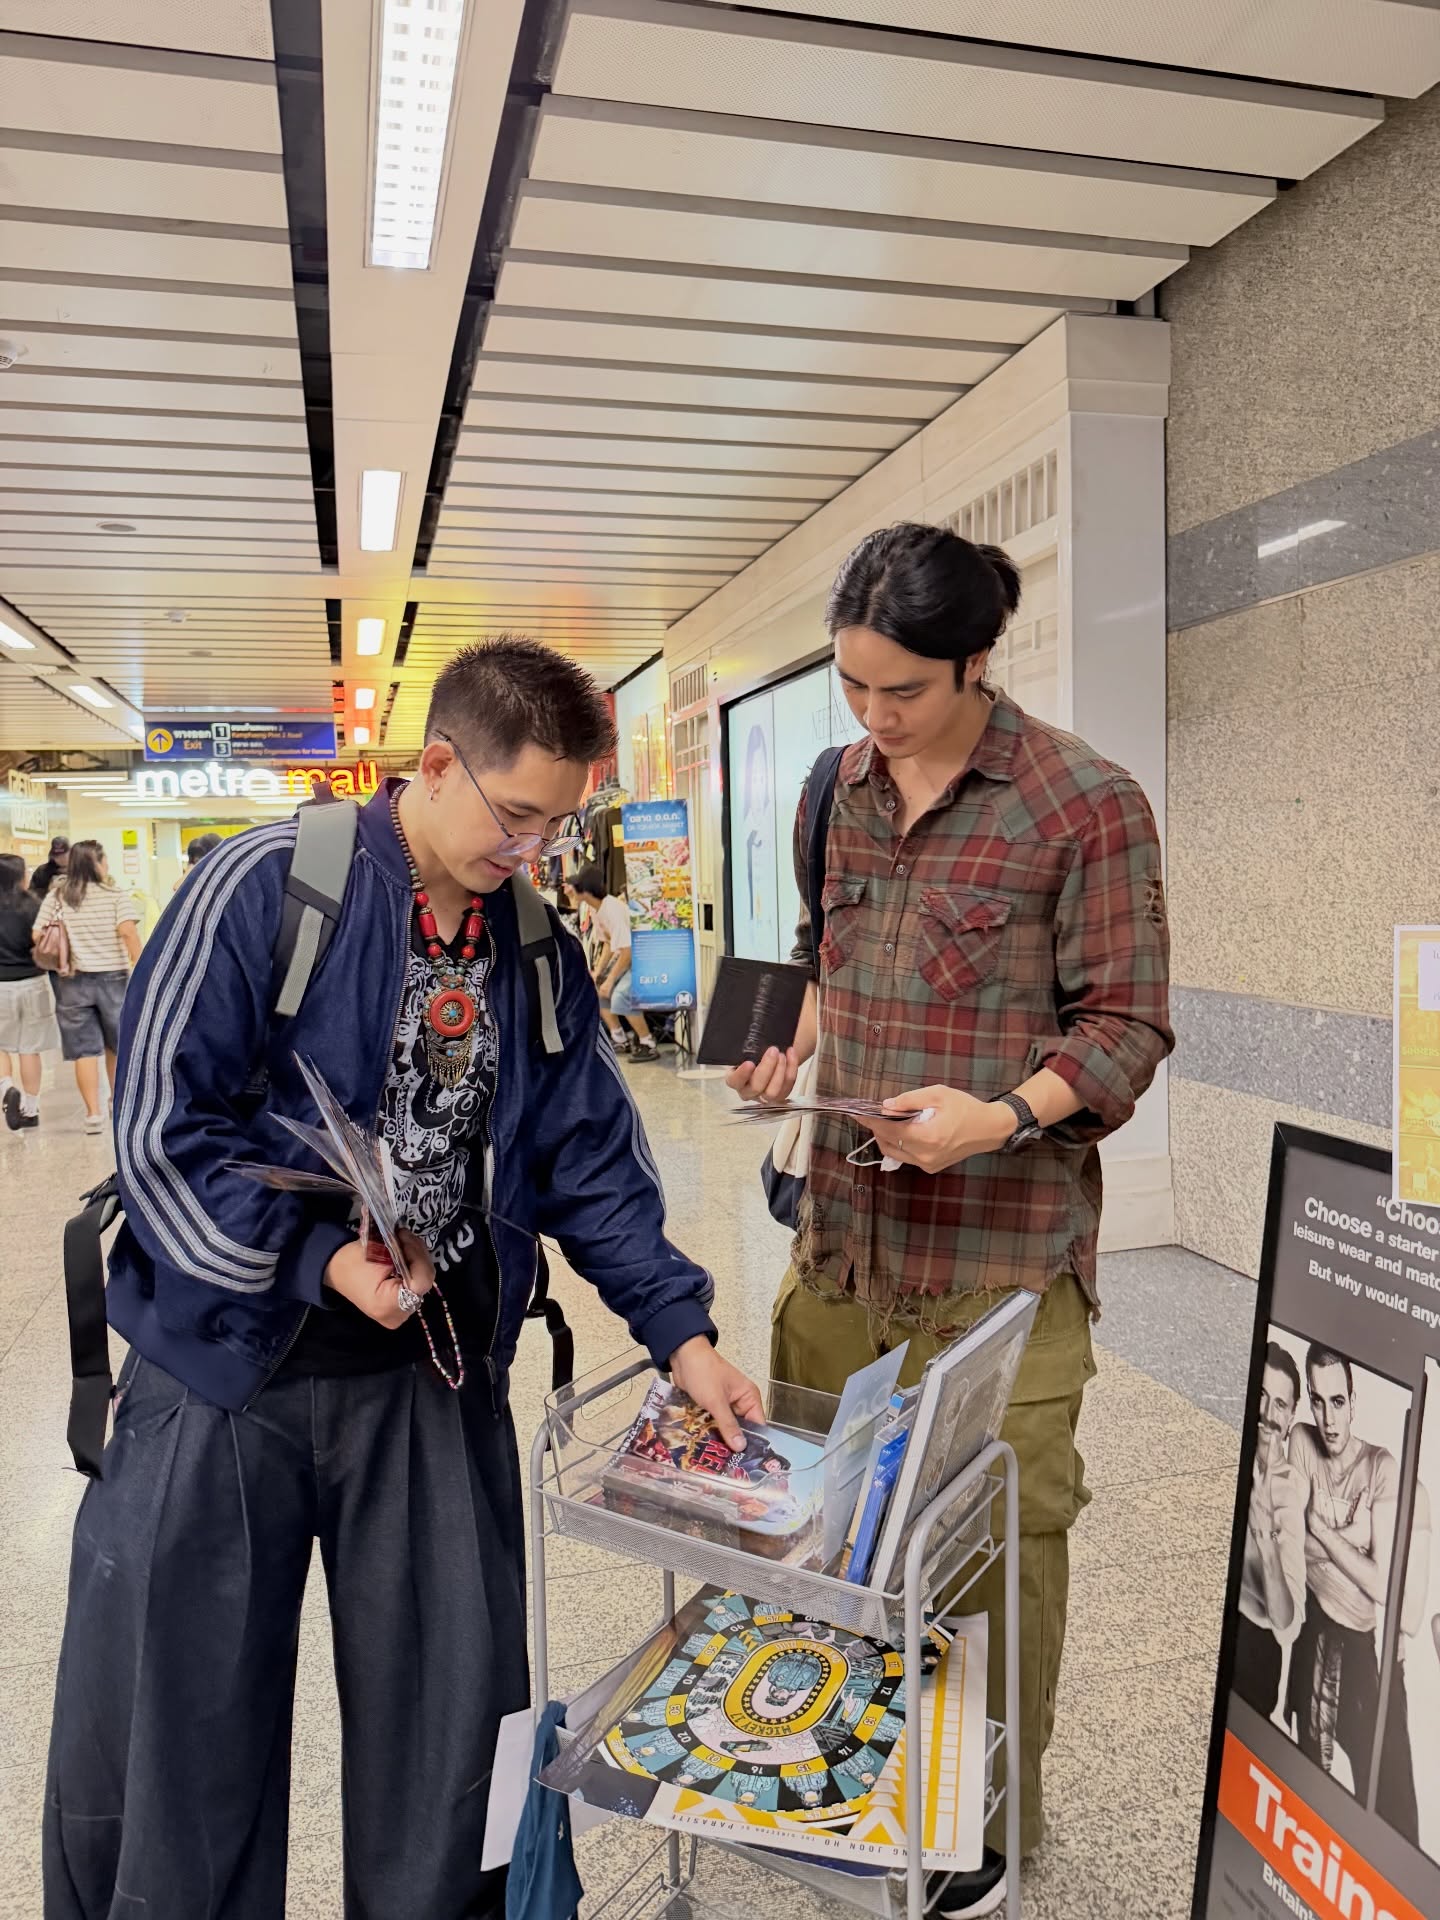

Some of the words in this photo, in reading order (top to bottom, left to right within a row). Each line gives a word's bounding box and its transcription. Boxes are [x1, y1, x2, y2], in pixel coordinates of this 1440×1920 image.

[183, 740, 203, 750] Exit
[136, 761, 280, 797] metro
[287, 760, 379, 794] mall
[639, 976, 658, 985] EXIT
[660, 973, 668, 985] 3
[1376, 1195, 1440, 1235] “Choo
[1304, 1197, 1373, 1238] Choose
[1375, 1230, 1385, 1243] a
[1388, 1234, 1440, 1262] starter
[1293, 1221, 1335, 1249] leisure
[1338, 1240, 1372, 1264] wear
[1375, 1255, 1402, 1276] and
[1308, 1259, 1332, 1282] But
[1335, 1272, 1362, 1296] why
[1365, 1284, 1409, 1314] would
[1411, 1304, 1440, 1329] any
[729, 1624, 744, 1632] 06
[682, 1673, 697, 1685] 04
[880, 1686, 893, 1696] 12
[730, 1712, 745, 1724] 17
[741, 1722, 792, 1737] MICKEY
[676, 1731, 692, 1744] 02
[838, 1745, 853, 1757] 14
[750, 1766, 764, 1775] 16
[671, 1813, 735, 1830] PARASITE
[823, 1839, 840, 1849] HO
[848, 1842, 883, 1853] JOON
[1249, 1763, 1398, 1920] Train
[892, 1847, 927, 1858] BNG
